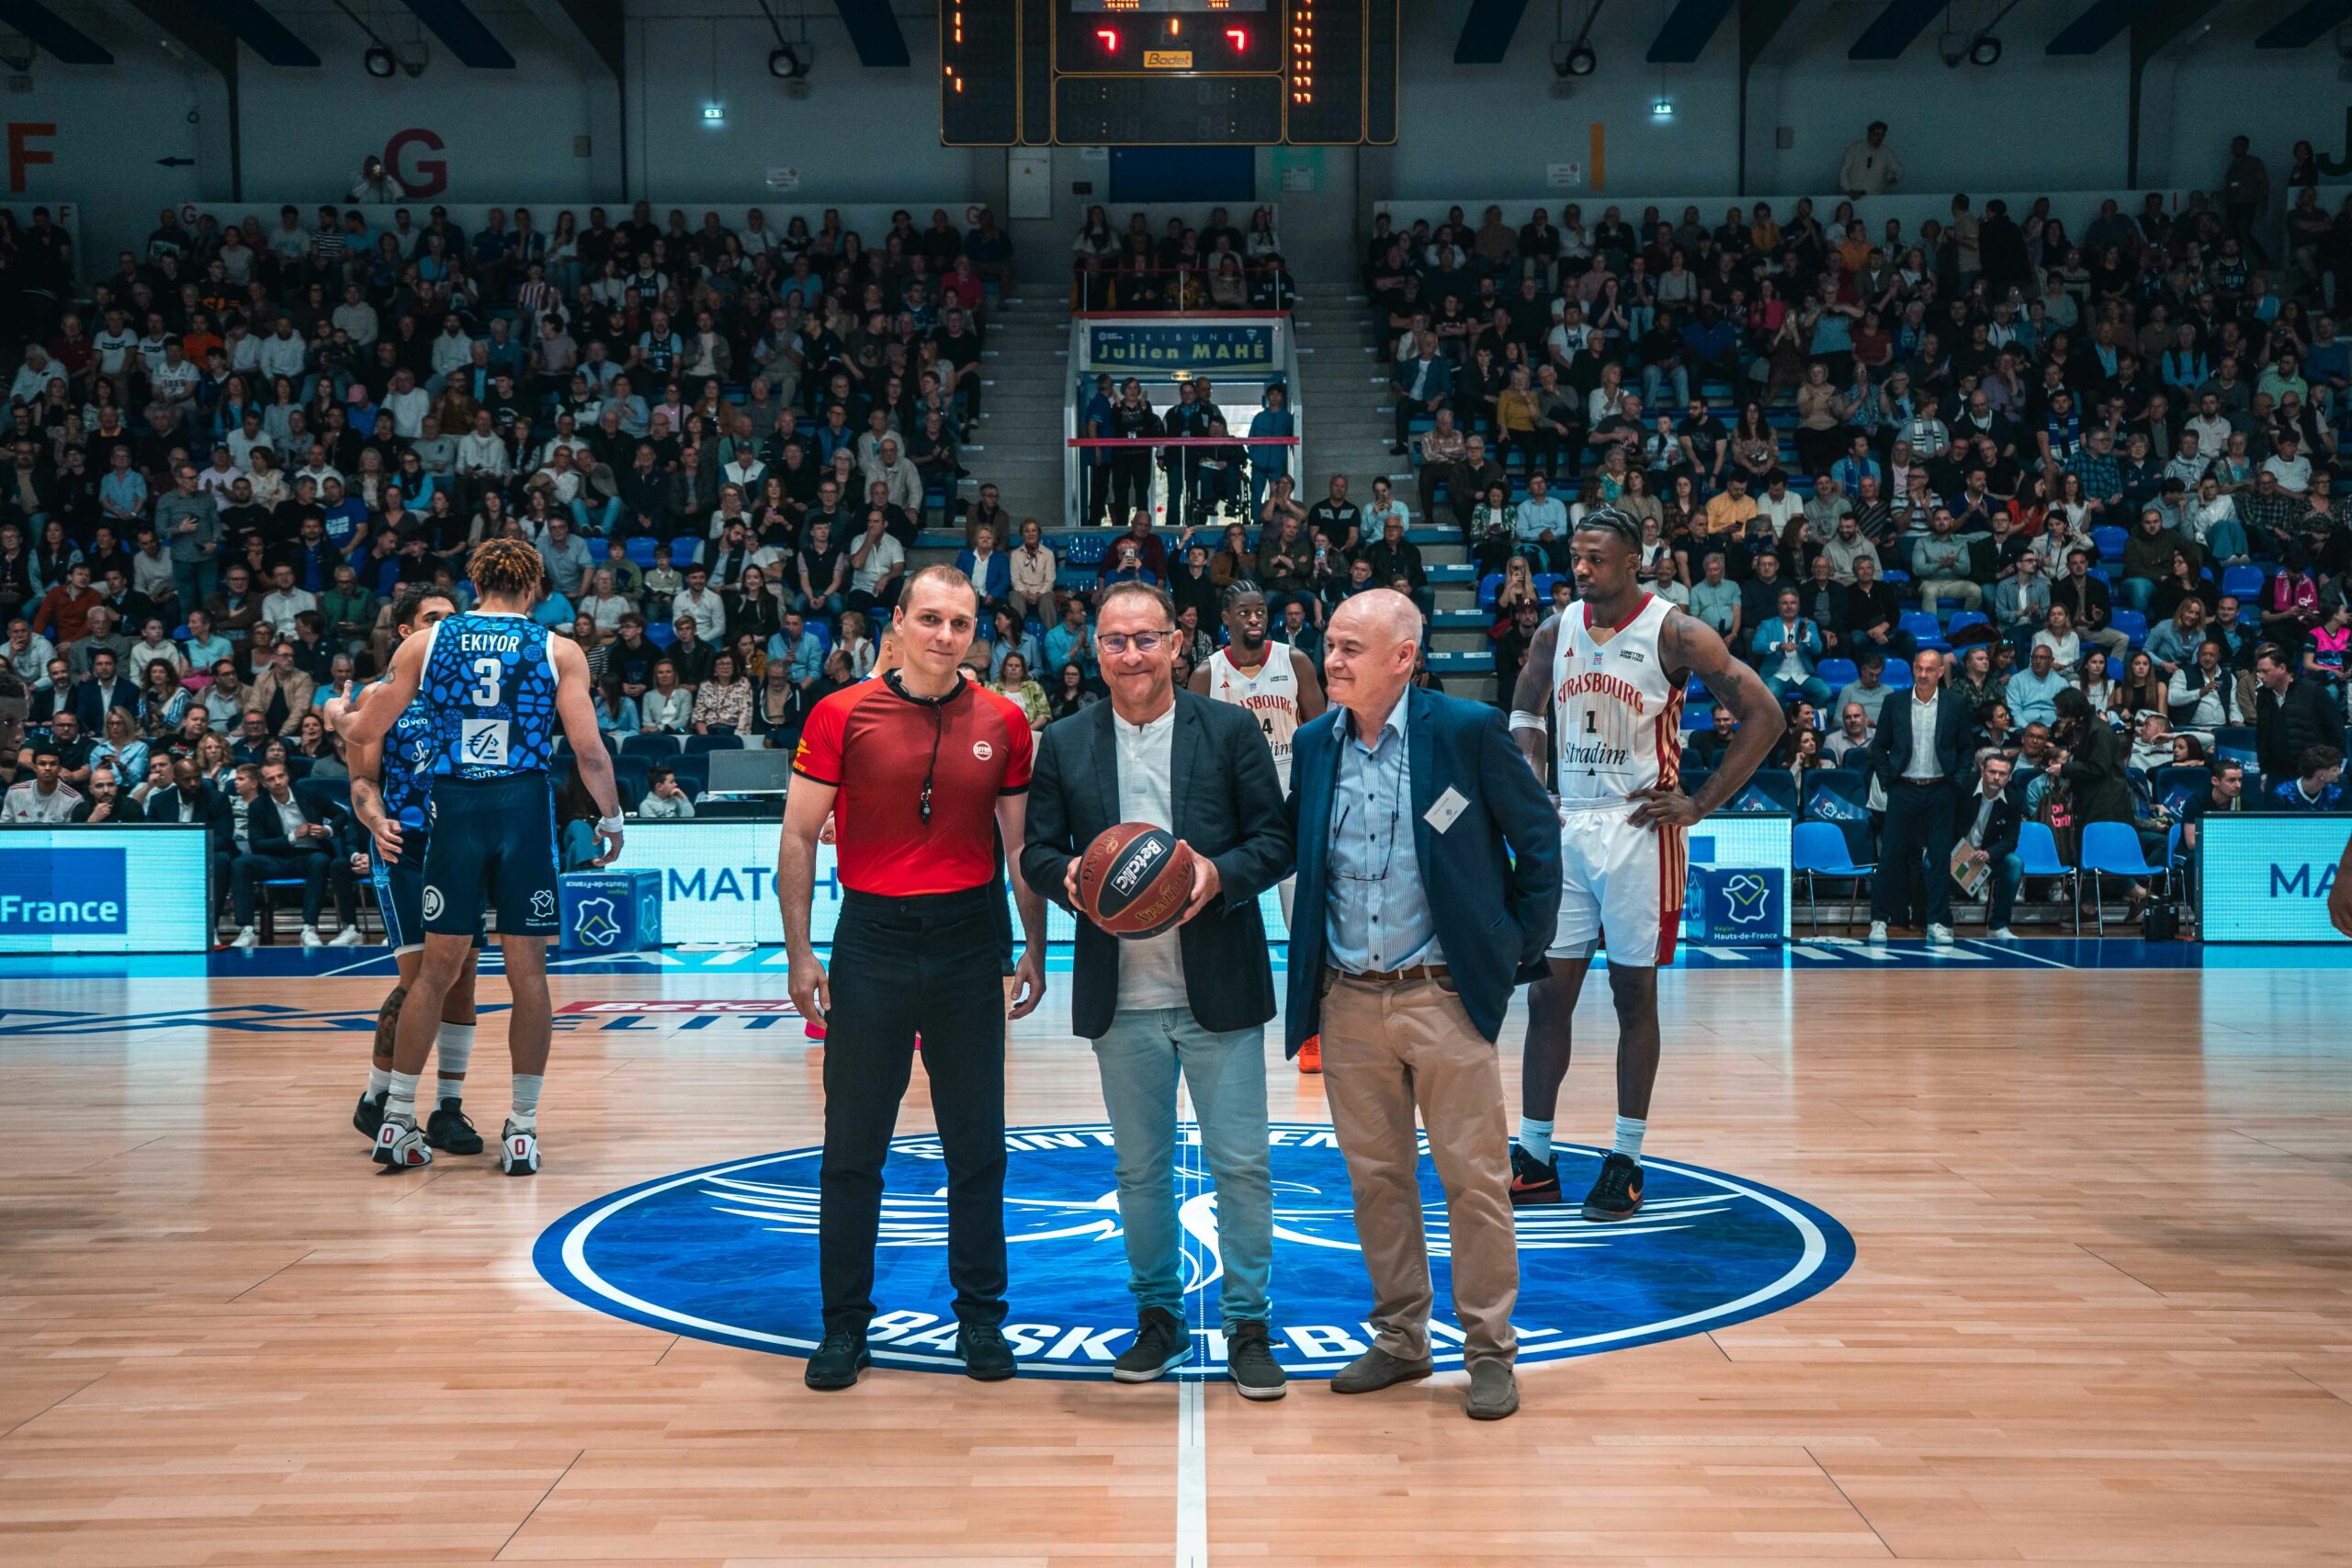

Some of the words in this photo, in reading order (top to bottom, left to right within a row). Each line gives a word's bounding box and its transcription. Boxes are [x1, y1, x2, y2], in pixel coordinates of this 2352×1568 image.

[1147, 52, 1190, 65] Bodet
[7, 122, 56, 193] F
[382, 128, 447, 199] G
[59, 205, 71, 224] F
[1099, 343, 1180, 359] Julien
[1192, 339, 1265, 359] MAHÉ
[1130, 333, 1233, 342] TRIBUNE
[461, 634, 520, 653] EKIYOR
[1620, 649, 1645, 659] LUNETTES
[472, 658, 502, 707] 3
[1557, 672, 1644, 715] STRASBOURG
[1262, 718, 1273, 734] 4
[1586, 710, 1597, 733] 1
[1565, 740, 1625, 765] Stradim
[1116, 839, 1163, 890] Betclic
[668, 866, 837, 902] MATH
[0, 895, 119, 922] France
[580, 1002, 798, 1012] Betcl
[890, 1132, 1117, 1159] SINT
